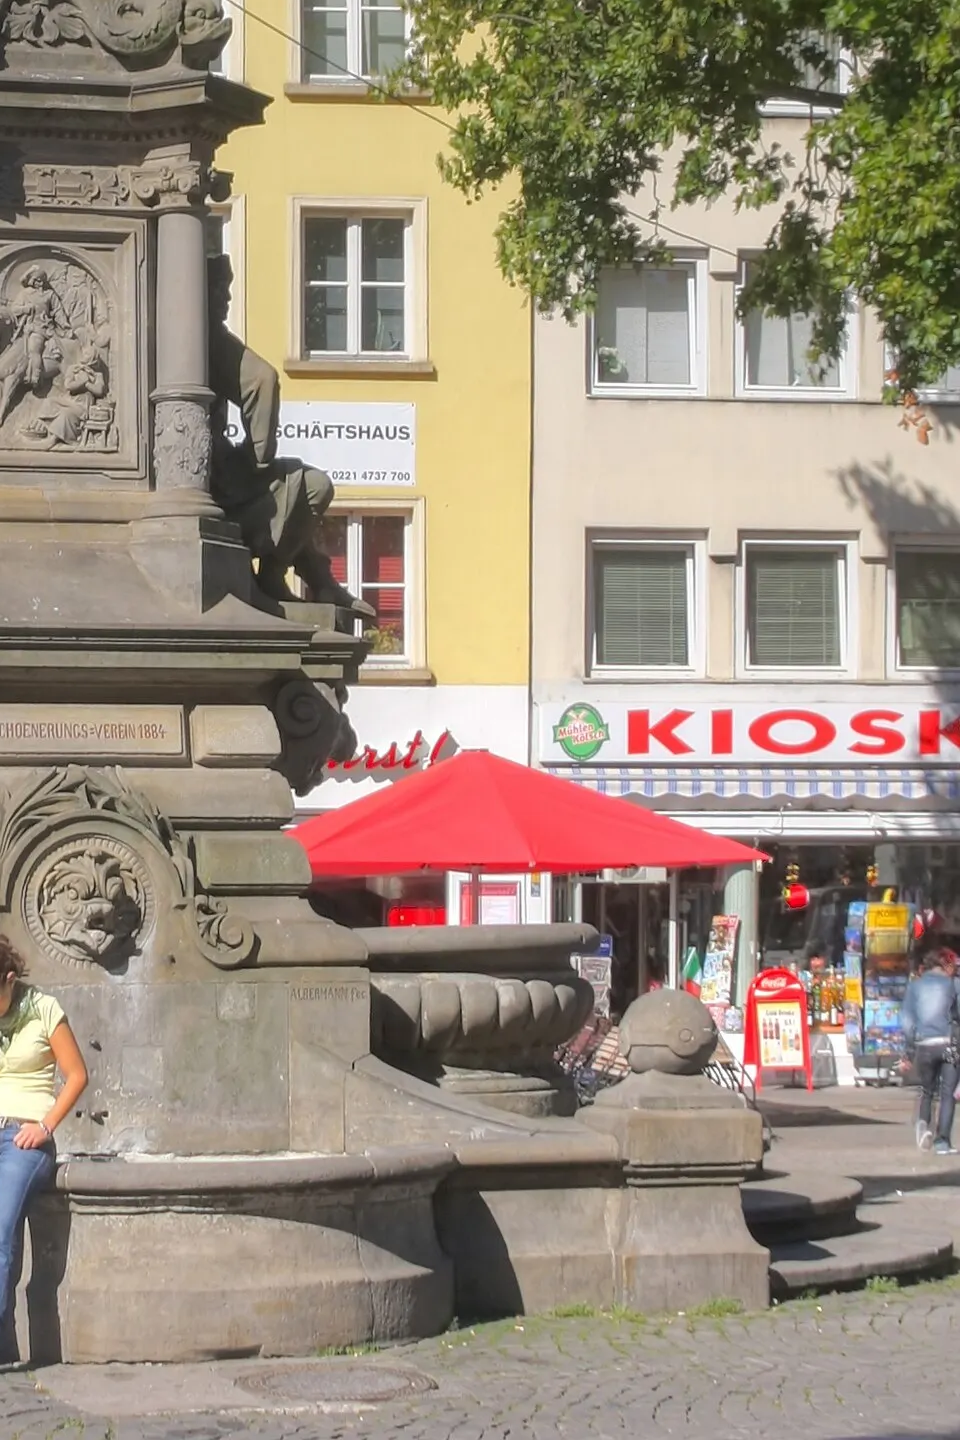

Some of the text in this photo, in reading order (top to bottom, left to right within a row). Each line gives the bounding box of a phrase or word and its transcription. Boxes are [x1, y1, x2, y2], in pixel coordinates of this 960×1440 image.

[332, 471, 410, 481] 0221 4737 700
[139, 723, 166, 740] 1884
[559, 723, 593, 737] Mühlen
[573, 729, 604, 743] Kölsch
[627, 708, 960, 755] KIOSK
[291, 987, 348, 1000] ALBERMANN
